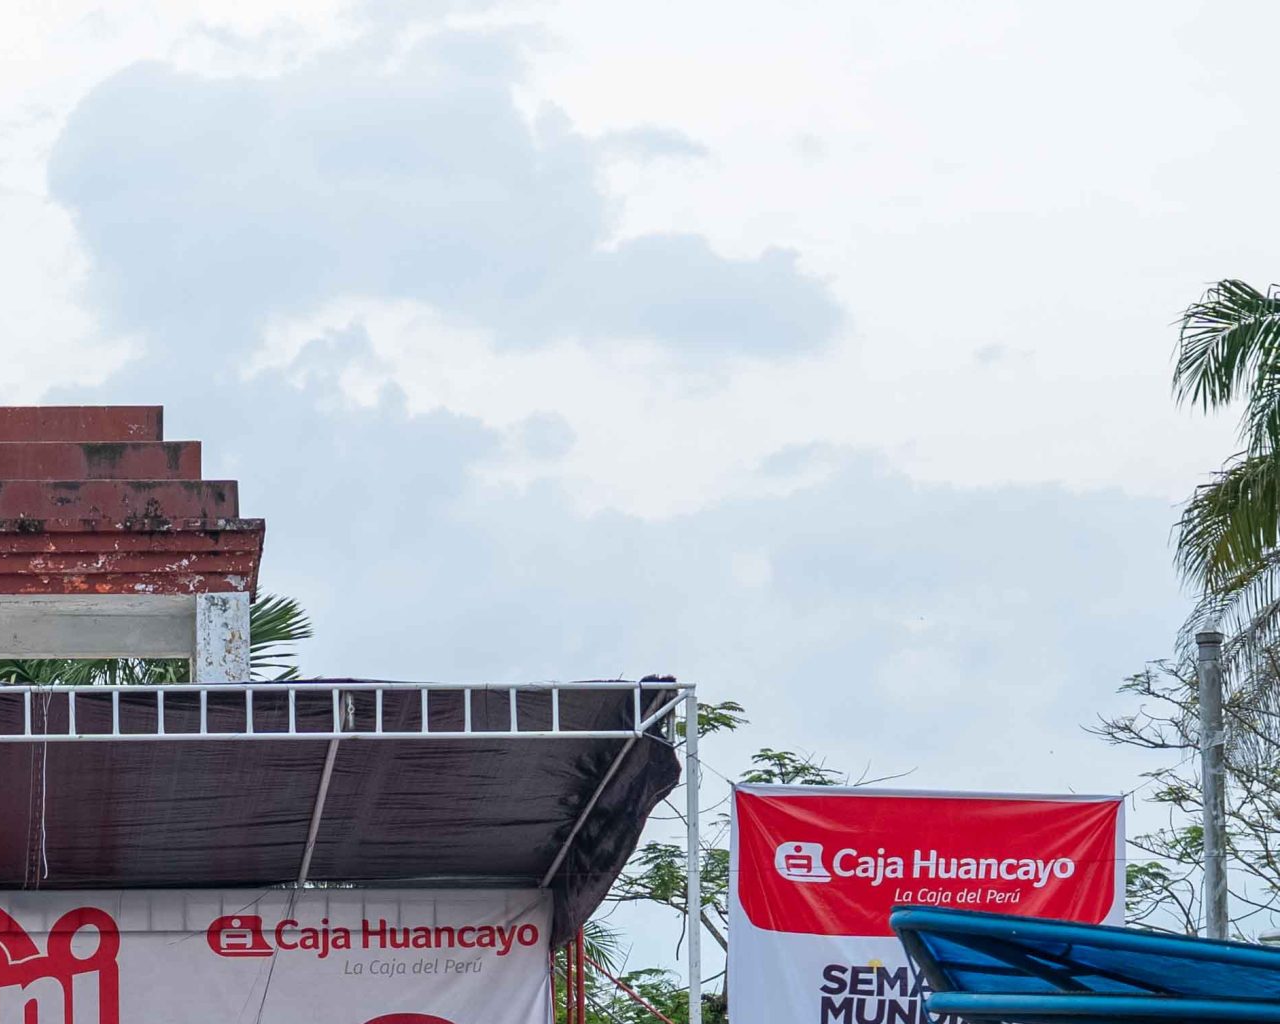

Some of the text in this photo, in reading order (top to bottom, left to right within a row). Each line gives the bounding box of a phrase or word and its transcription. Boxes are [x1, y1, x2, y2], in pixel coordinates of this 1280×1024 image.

[833, 848, 1075, 888] Caja Huancayo
[894, 888, 1020, 906] La Caja del Perú
[275, 919, 539, 958] Caja Huancayo
[344, 956, 482, 978] La Caja del Perú
